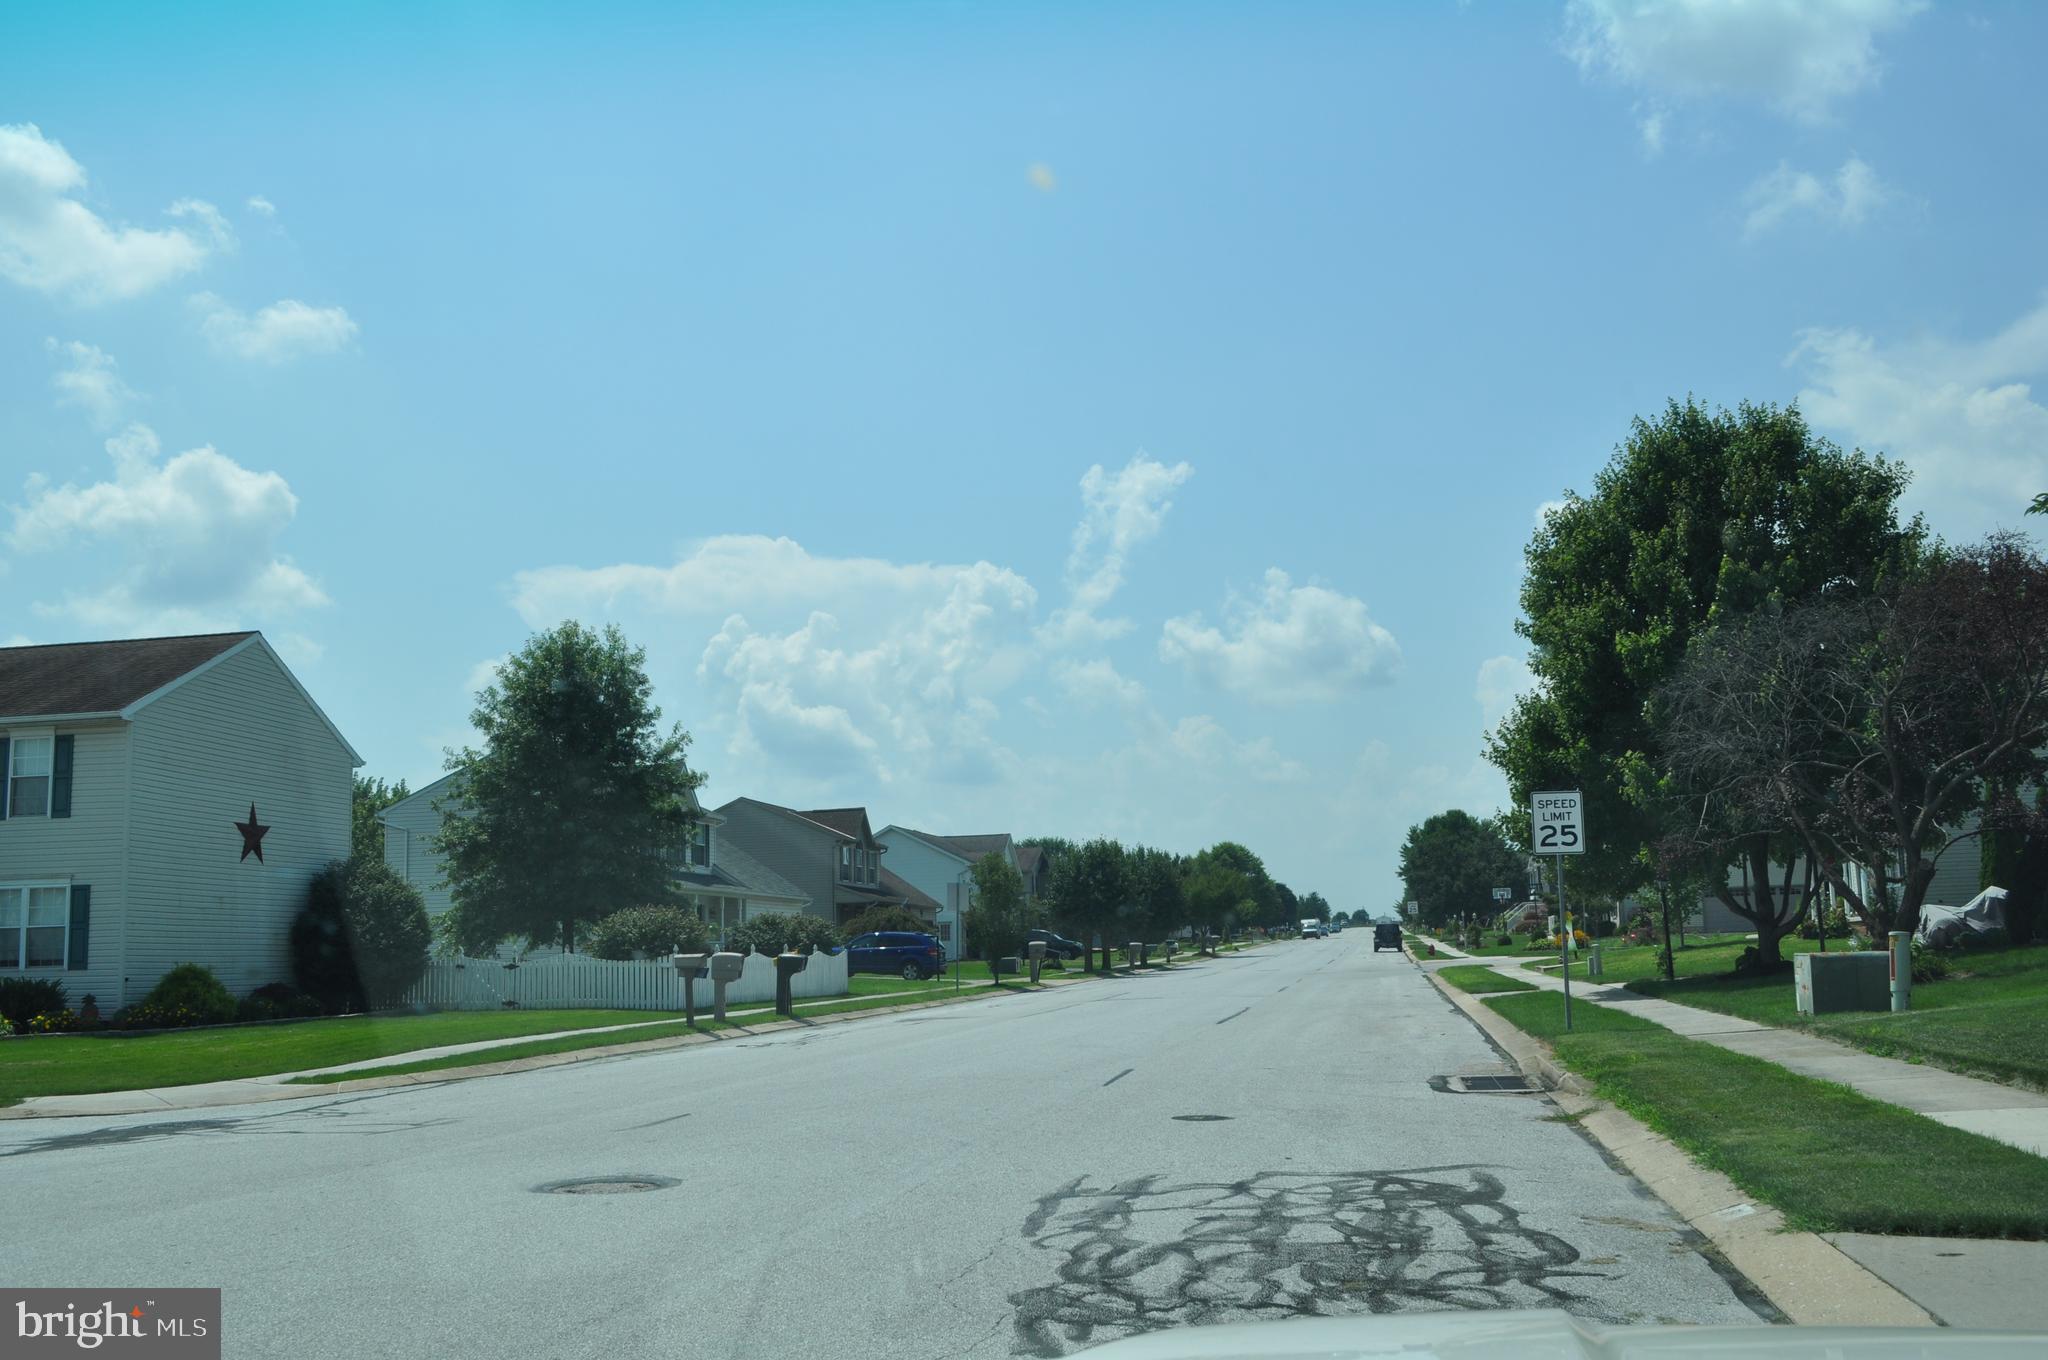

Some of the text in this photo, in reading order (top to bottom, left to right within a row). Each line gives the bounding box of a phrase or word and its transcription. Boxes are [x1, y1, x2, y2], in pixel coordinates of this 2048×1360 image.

[1537, 799, 1577, 809] SPEED
[1542, 811, 1572, 821] LIMIT
[1539, 824, 1578, 847] 25
